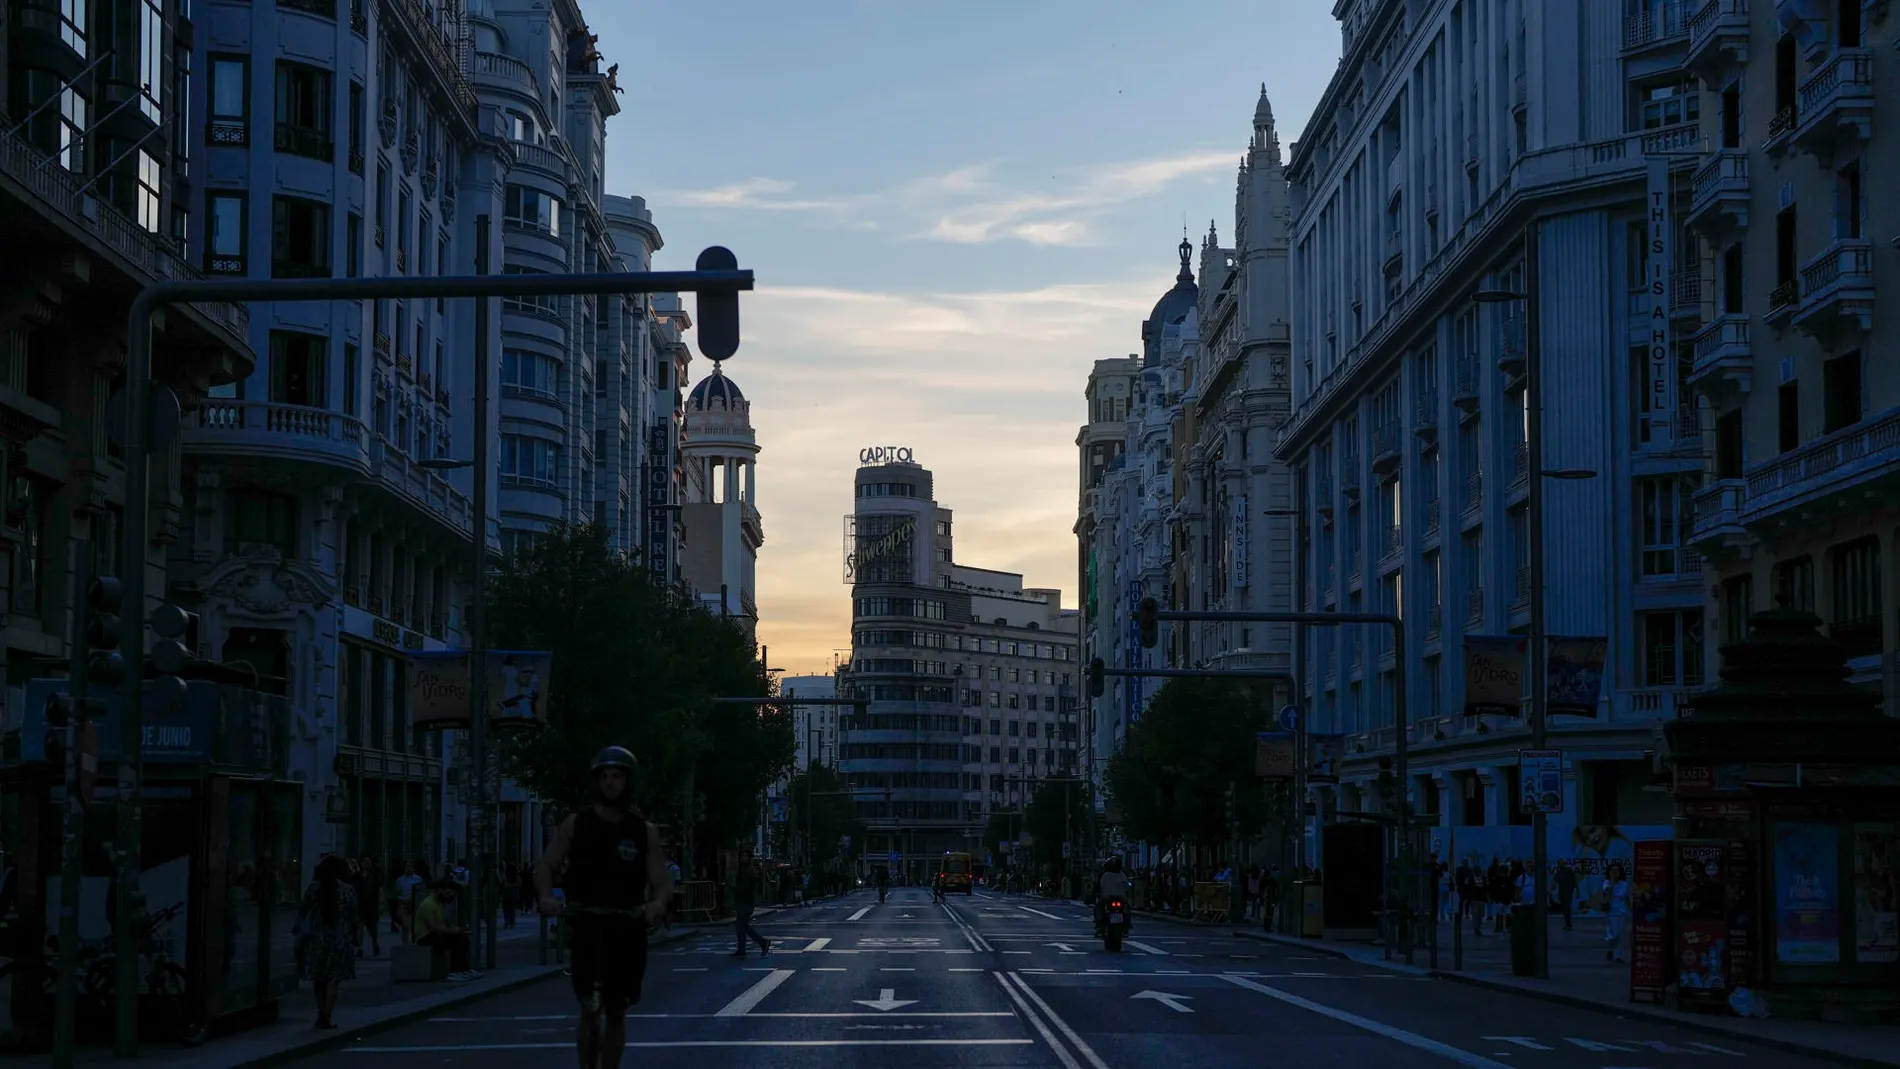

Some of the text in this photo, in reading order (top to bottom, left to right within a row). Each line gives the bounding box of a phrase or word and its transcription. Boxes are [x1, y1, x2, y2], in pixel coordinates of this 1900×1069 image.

[1652, 191, 1665, 410] THIS IS A HOTEL
[859, 446, 916, 463] CAPITOL
[652, 454, 668, 535] HOTEL
[1236, 503, 1245, 582] INNSIDE
[1131, 581, 1141, 630] HOTL
[156, 726, 191, 746] JUNIO
